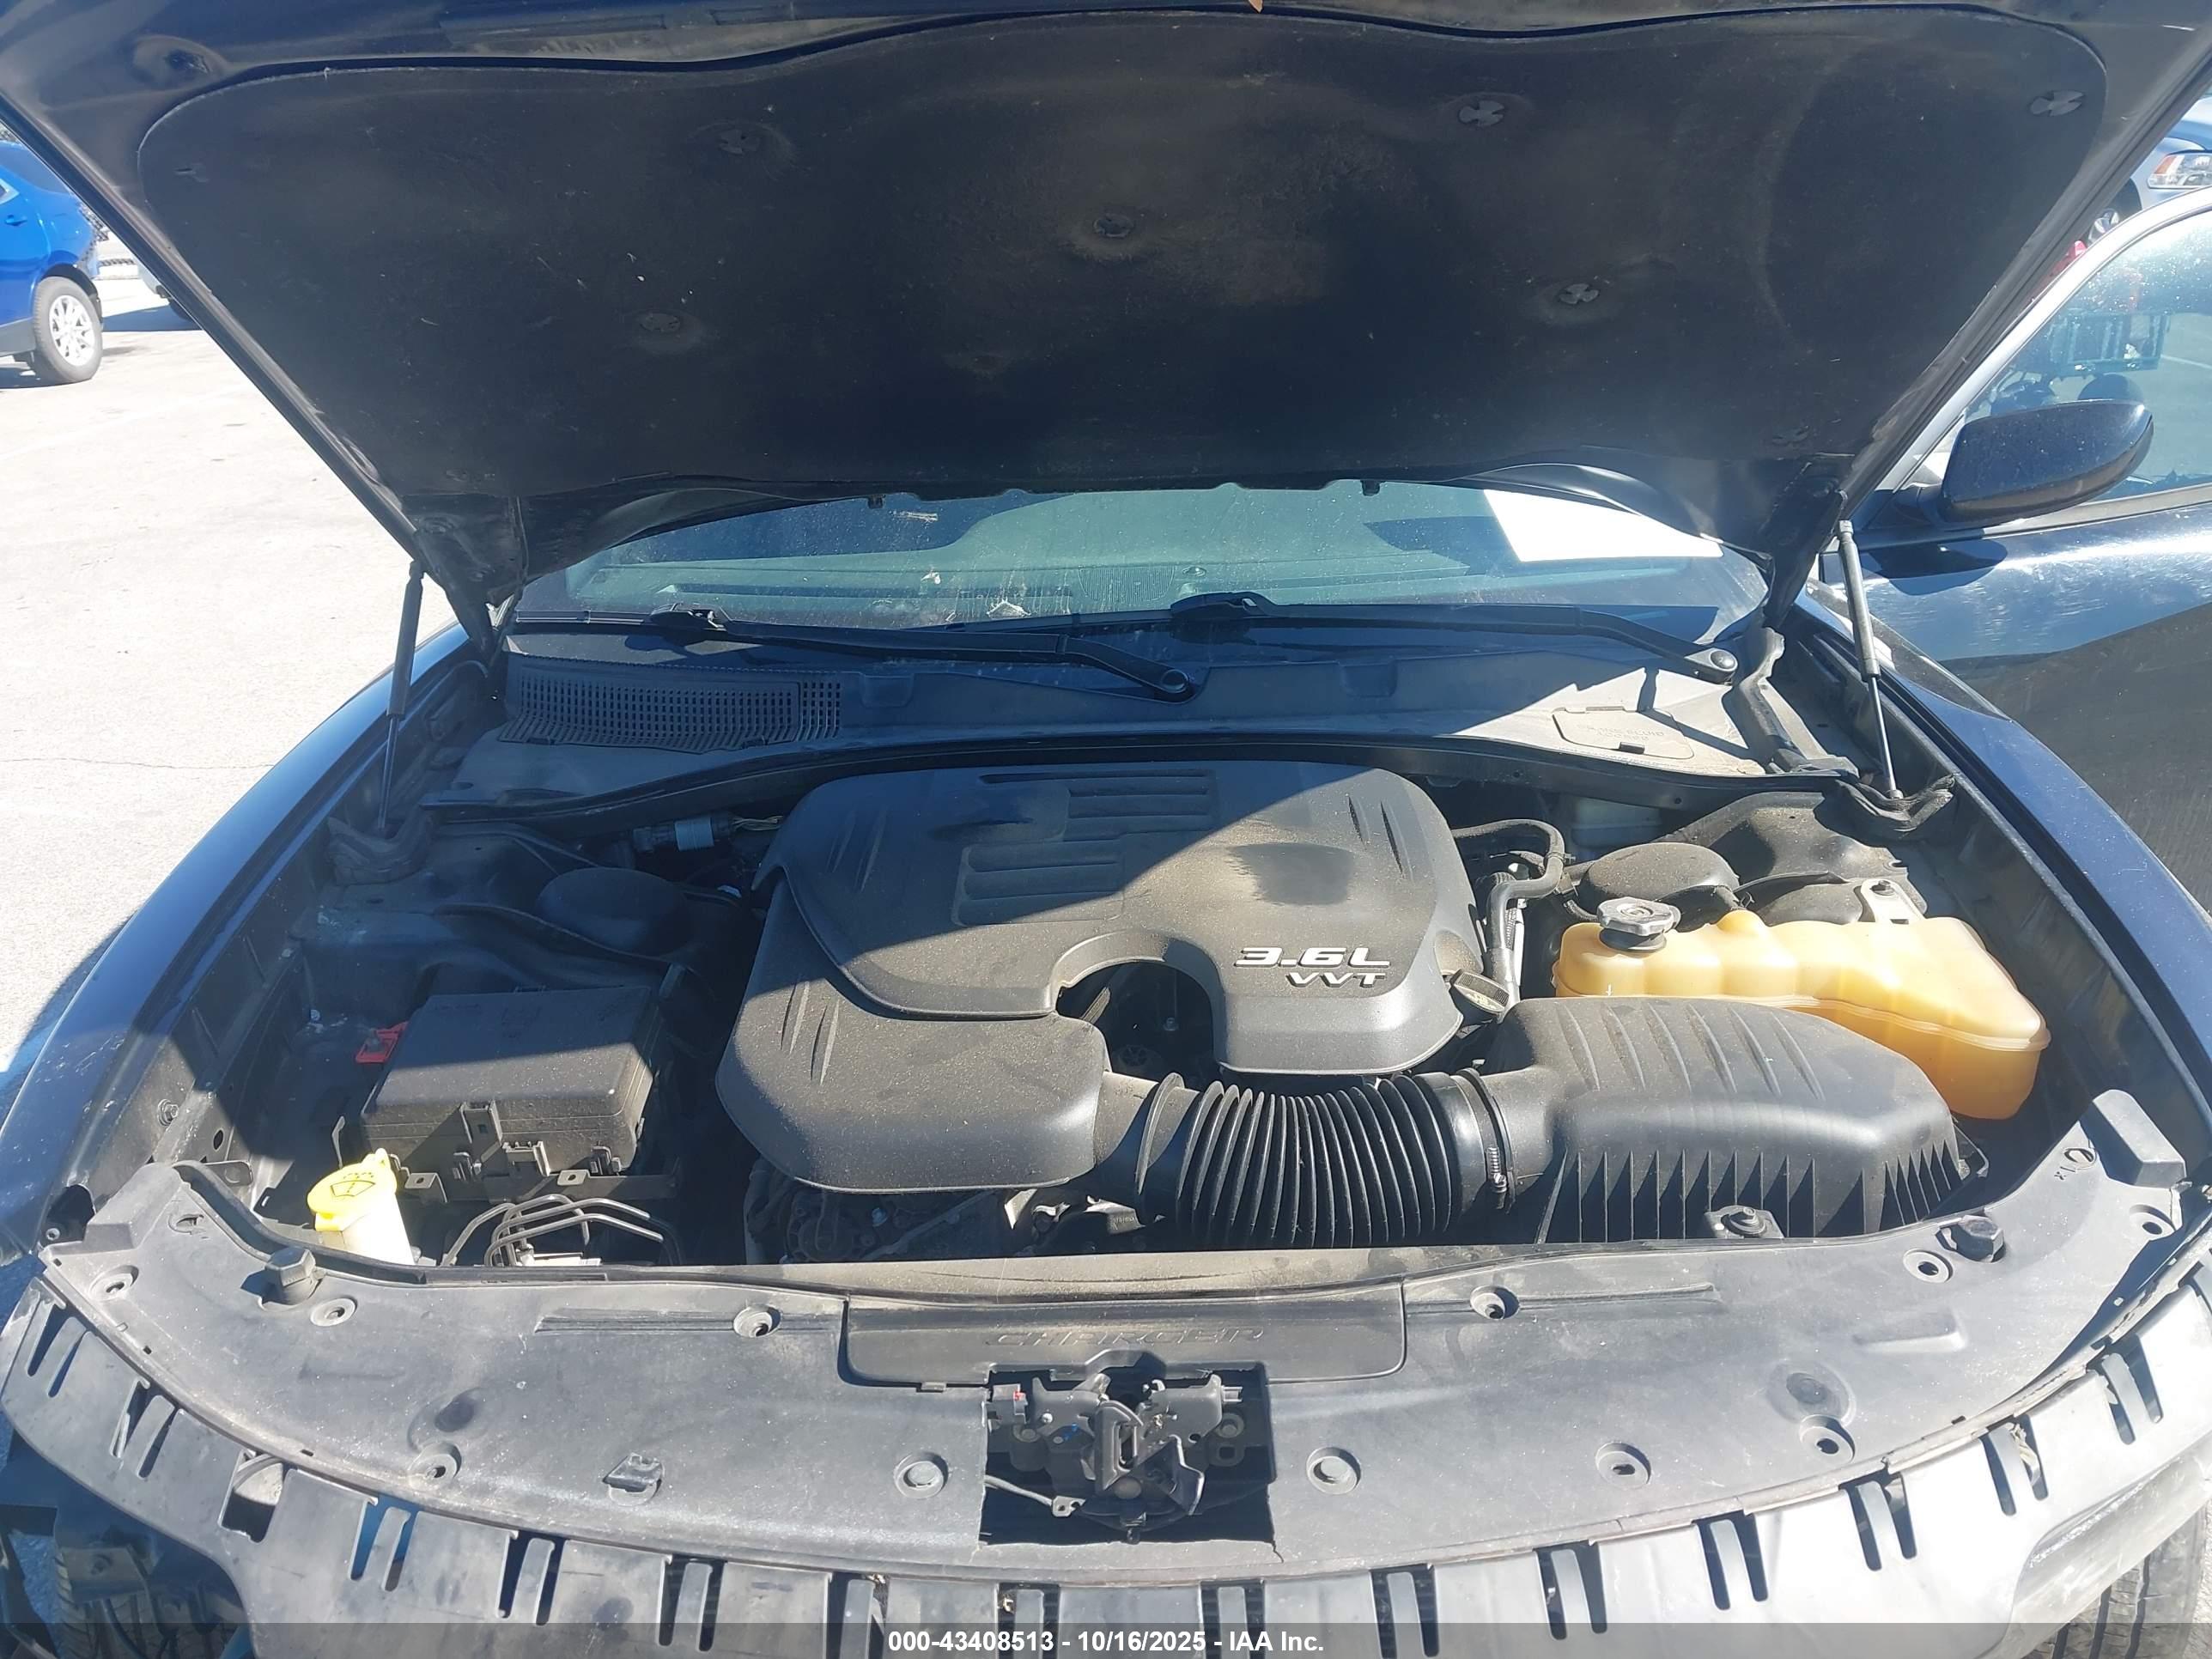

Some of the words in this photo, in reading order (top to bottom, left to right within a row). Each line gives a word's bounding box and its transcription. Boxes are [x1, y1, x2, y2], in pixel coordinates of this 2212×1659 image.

[1234, 946, 1391, 969] 3.6L
[1285, 971, 1387, 989] VVT
[985, 1327, 1265, 1346] CHARGER
